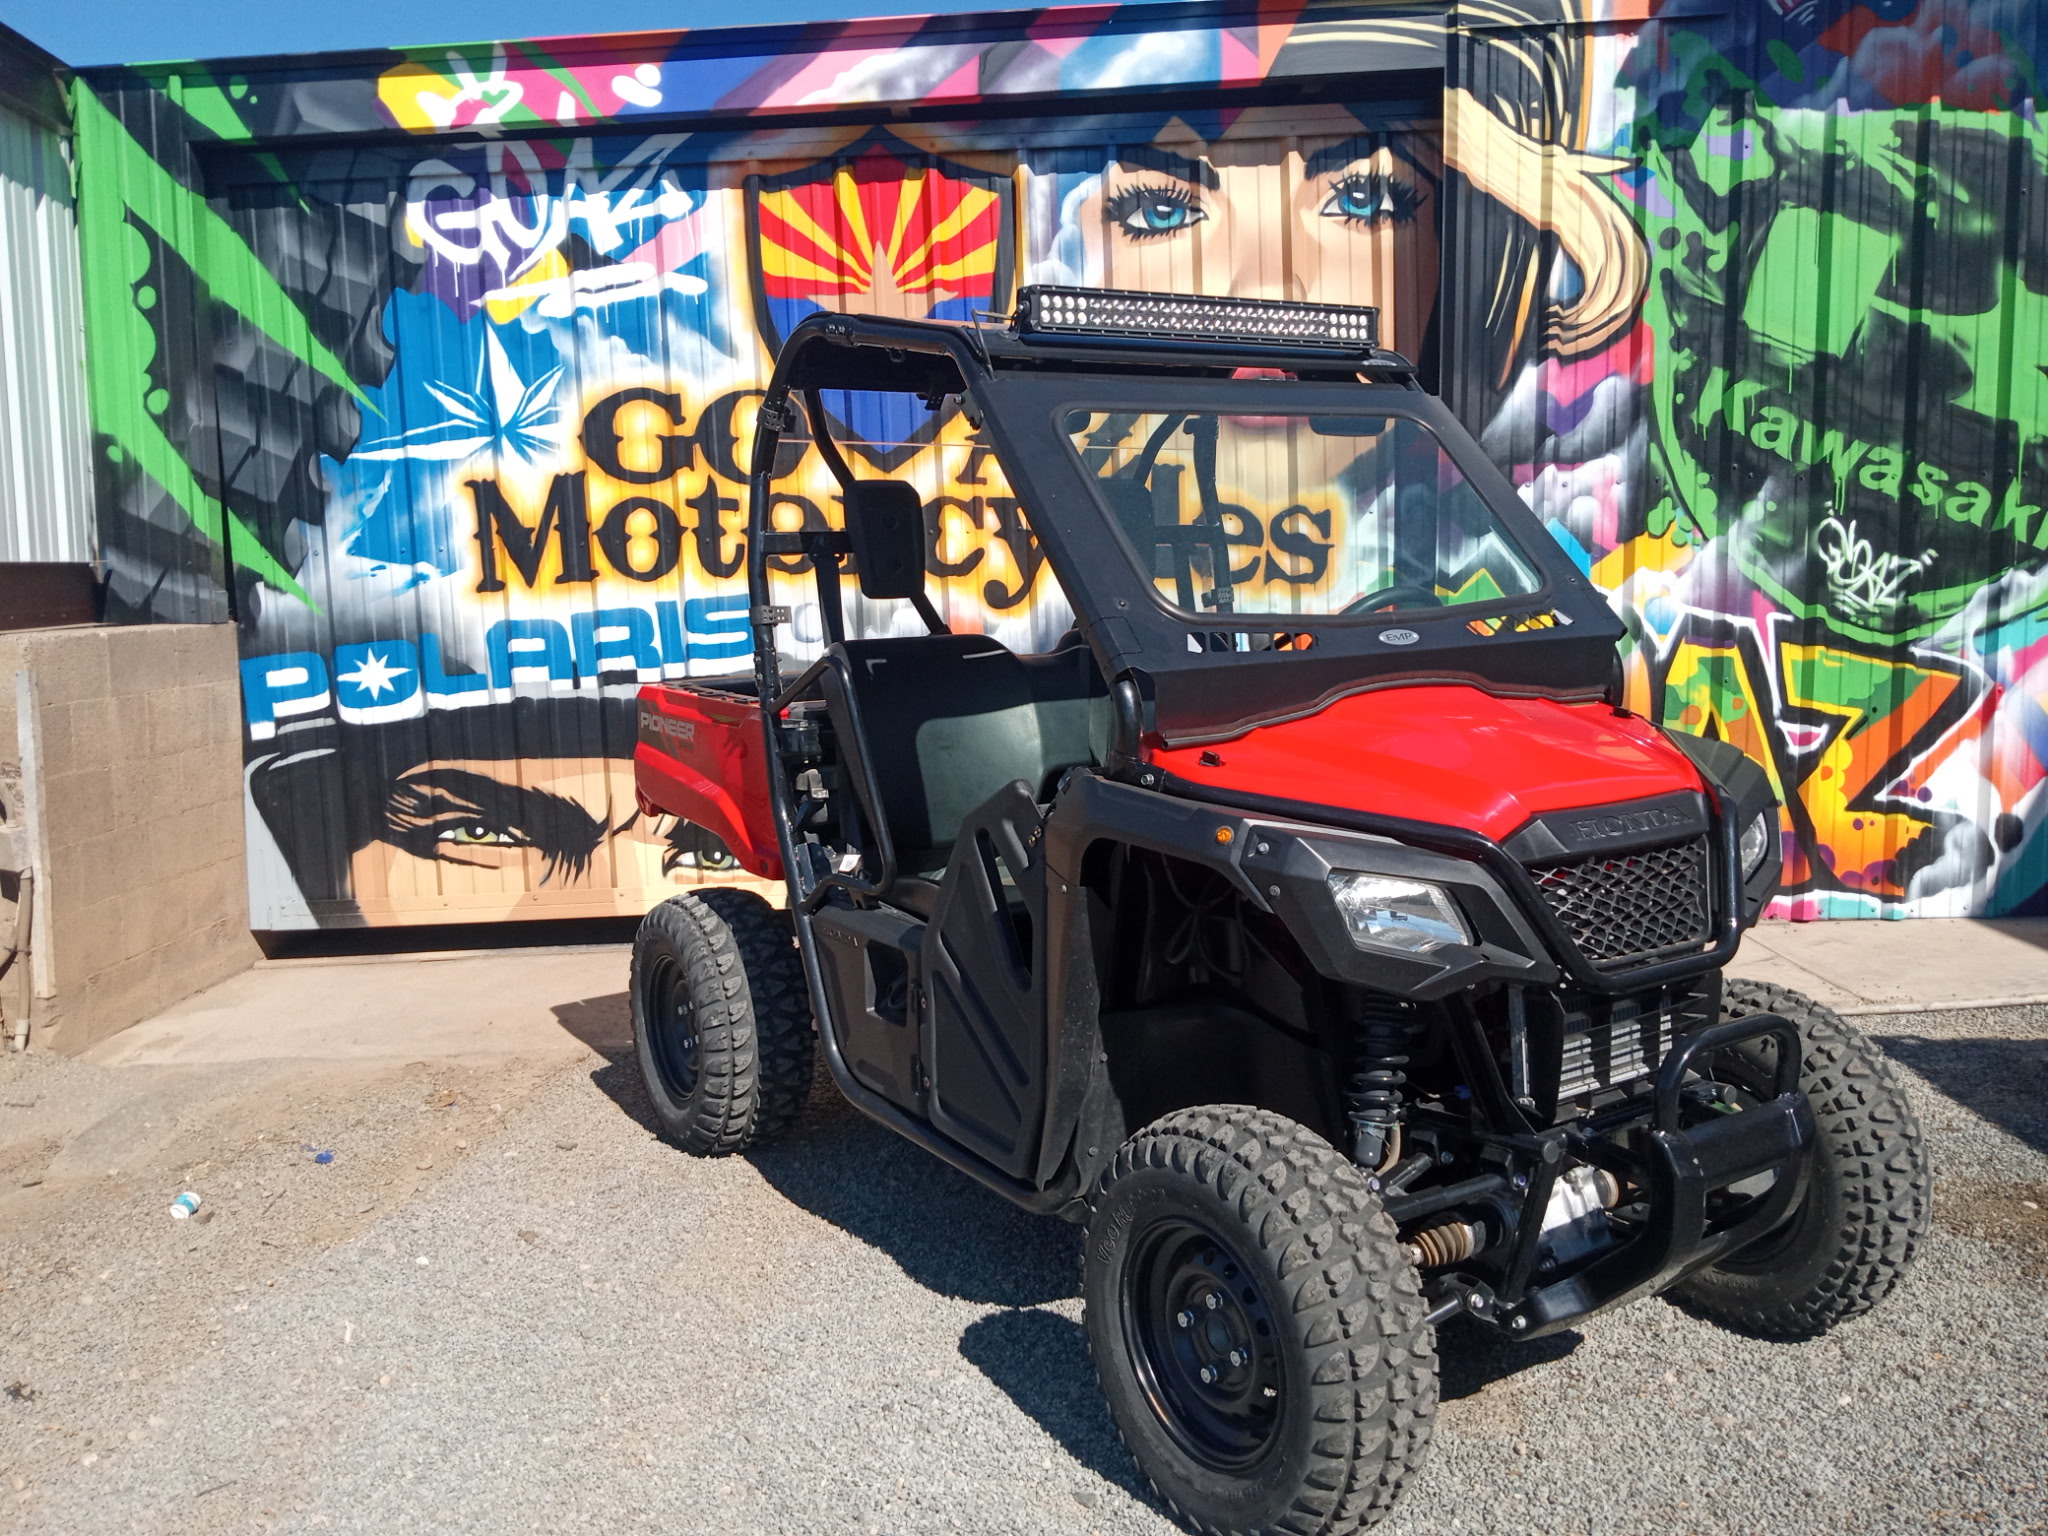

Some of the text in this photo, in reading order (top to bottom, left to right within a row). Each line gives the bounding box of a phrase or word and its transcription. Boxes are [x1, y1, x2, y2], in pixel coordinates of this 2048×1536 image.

[579, 388, 813, 487] GO
[1386, 632, 1412, 641] EMP
[240, 594, 757, 740] POLARIS
[640, 711, 695, 742] PIONEER
[1569, 804, 1694, 842] HONDA
